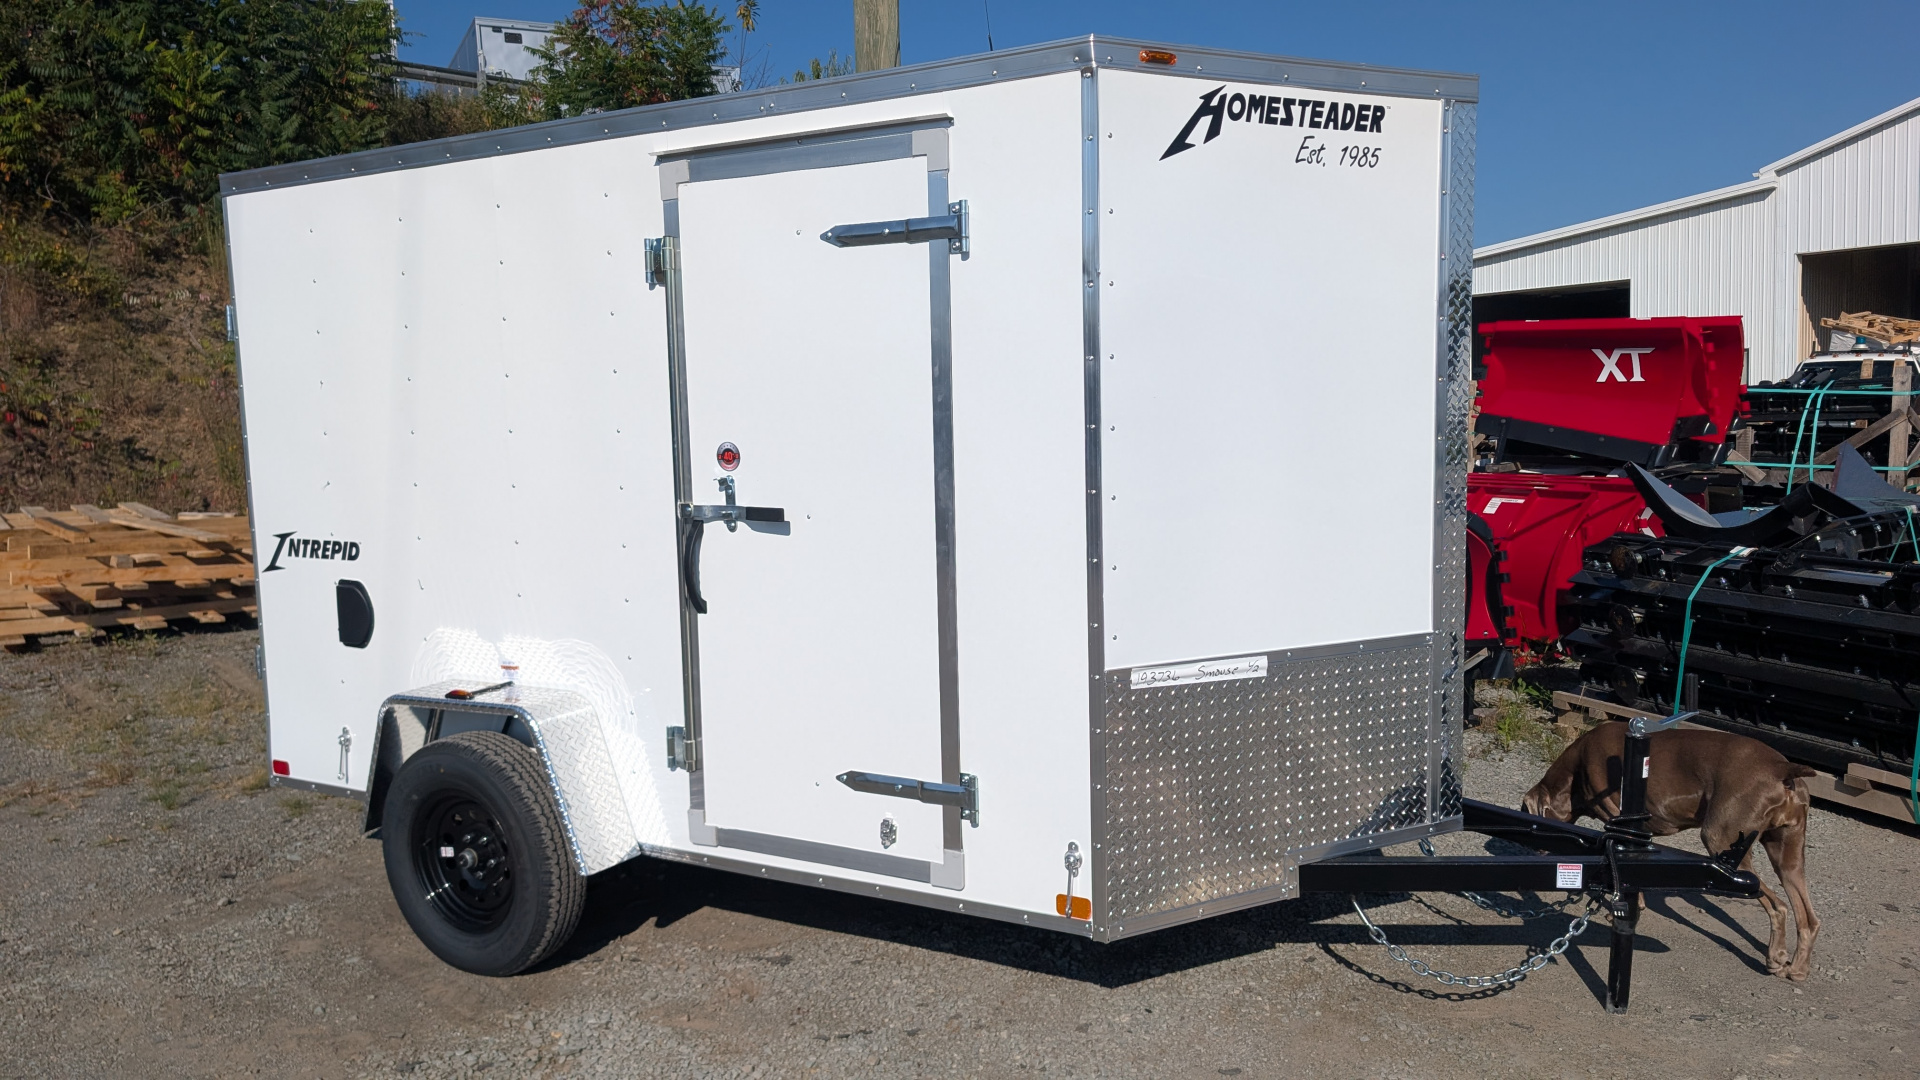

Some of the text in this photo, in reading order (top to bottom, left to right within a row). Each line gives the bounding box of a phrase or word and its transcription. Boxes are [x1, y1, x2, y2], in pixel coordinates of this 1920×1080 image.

[1158, 84, 1386, 161] HOMESTEADER
[1295, 135, 1382, 168] Est. 1985
[1591, 347, 1656, 382] XT
[261, 530, 361, 573] INTREPID
